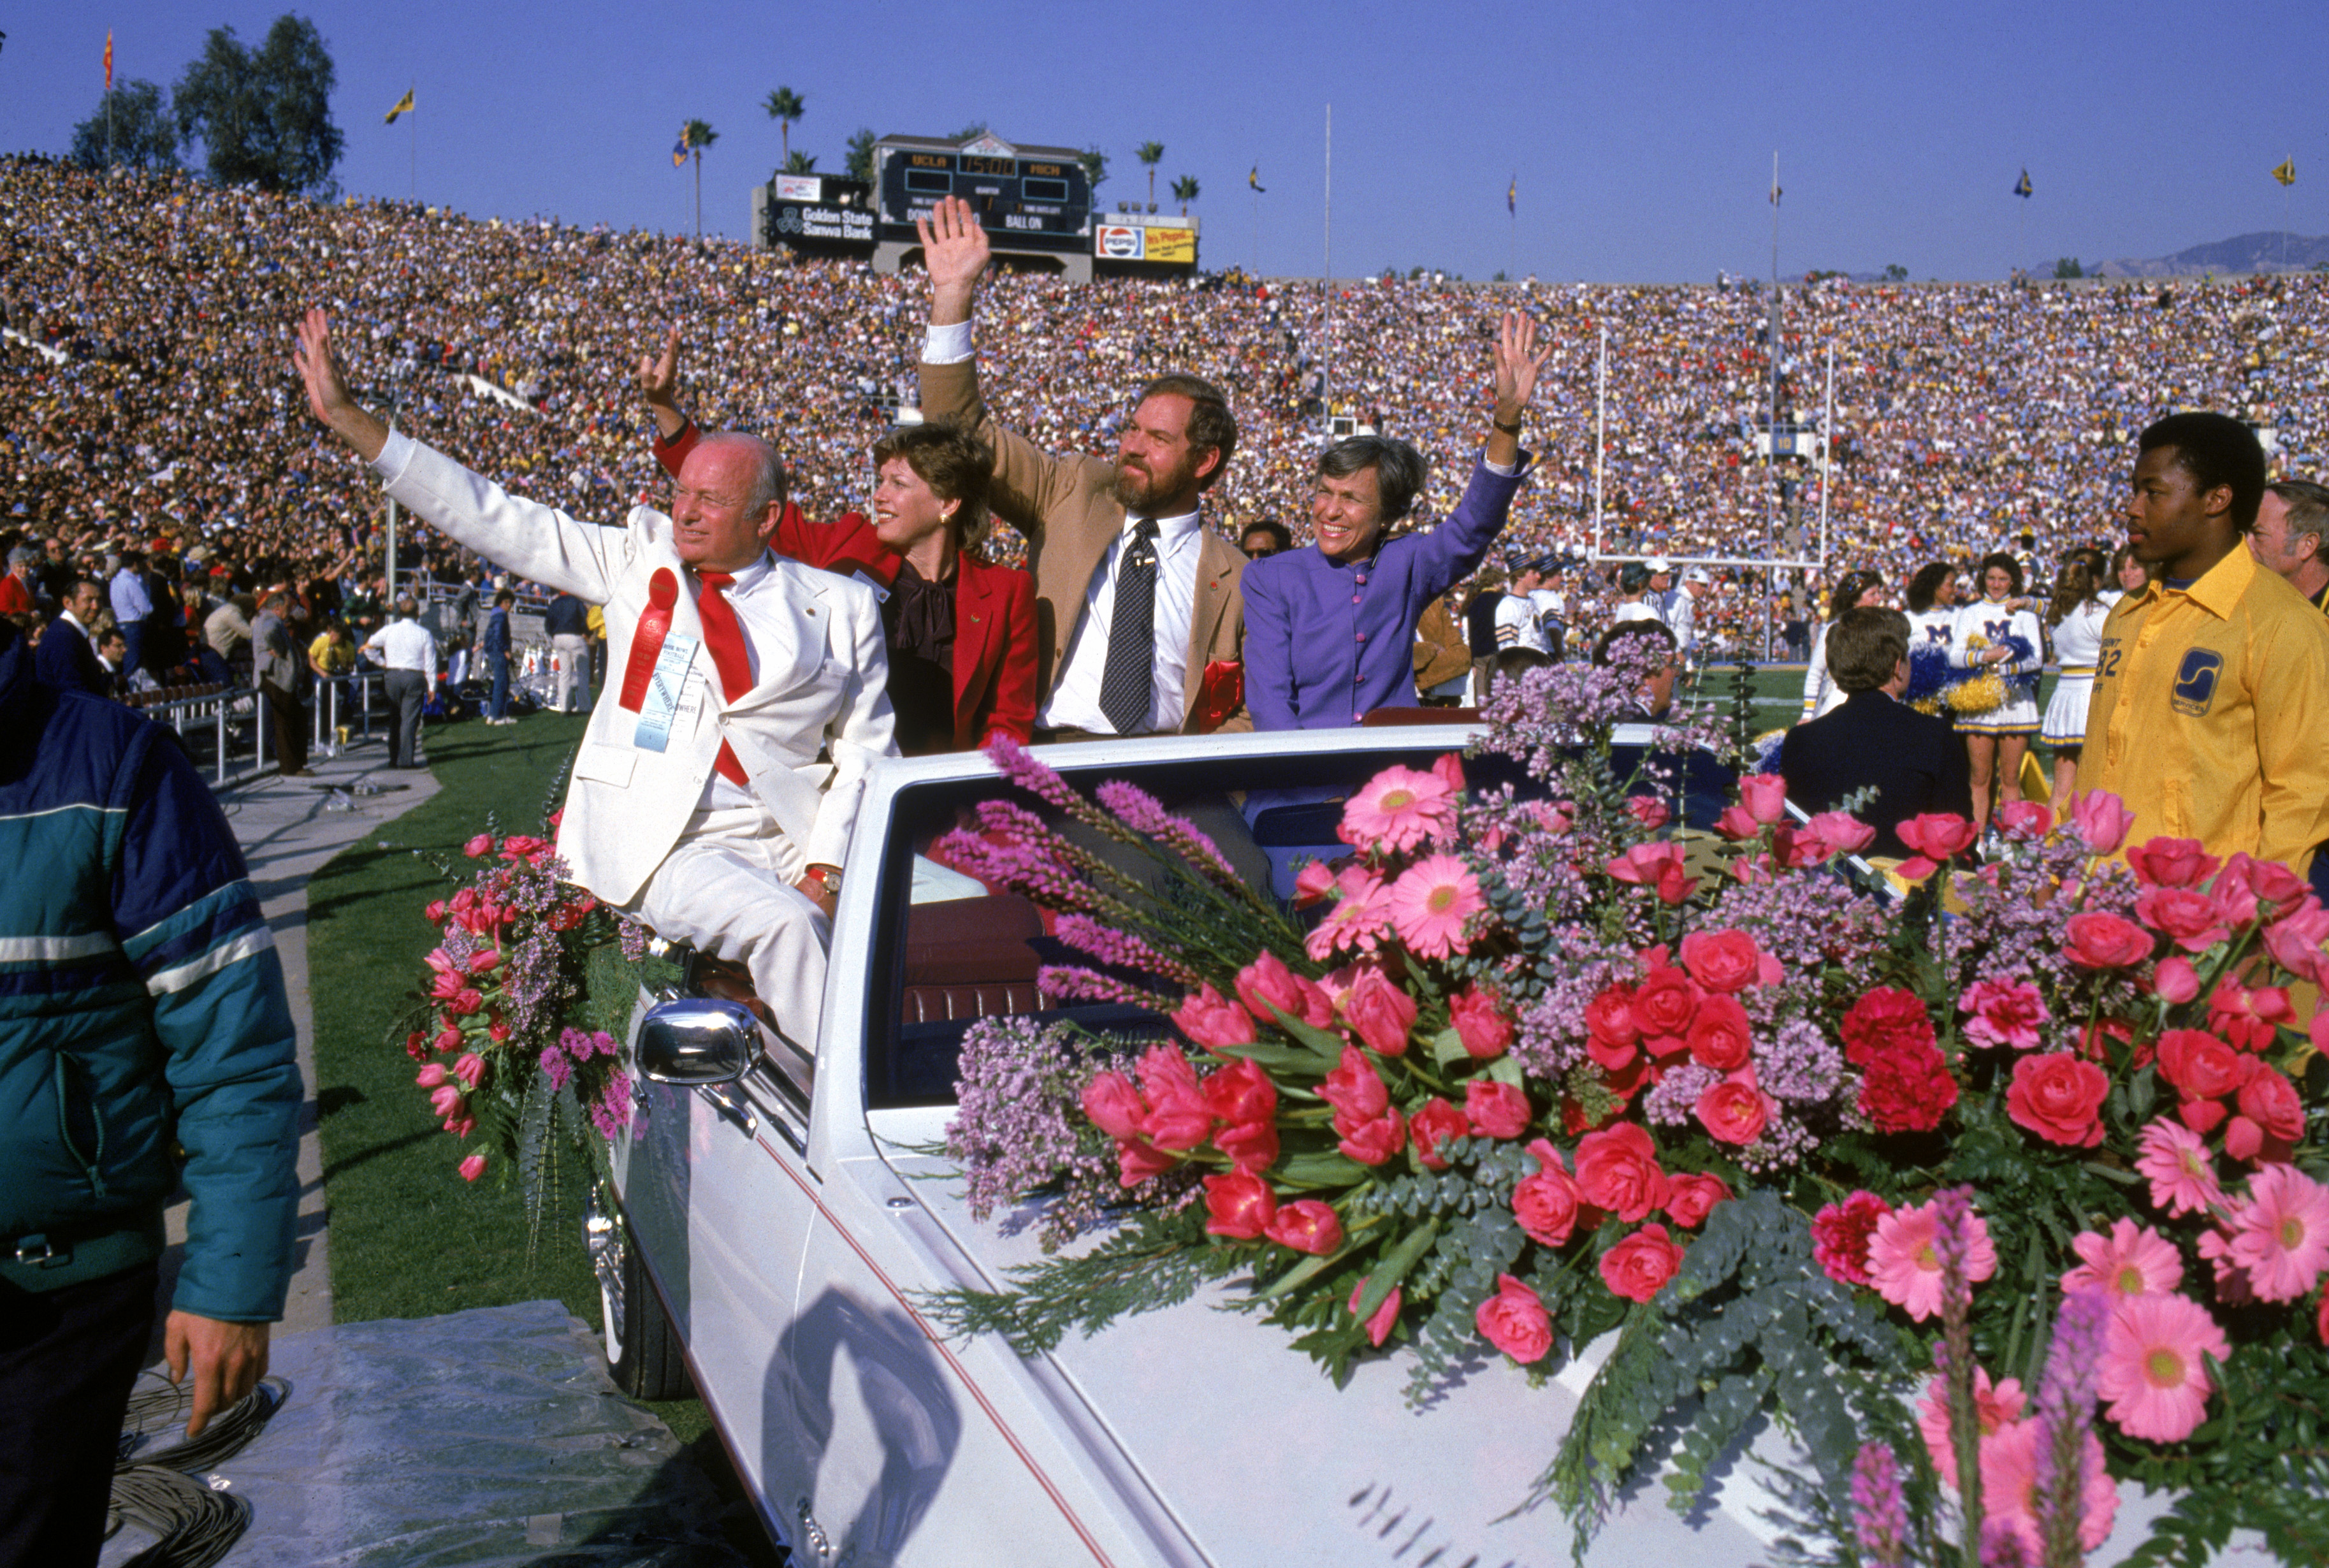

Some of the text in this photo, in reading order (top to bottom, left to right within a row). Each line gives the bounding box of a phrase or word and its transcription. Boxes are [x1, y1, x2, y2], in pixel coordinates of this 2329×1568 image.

[912, 155, 947, 168] UCLA
[966, 157, 1015, 175] 15:00
[1029, 164, 1061, 176] MICH
[802, 207, 873, 226] Golden State
[1005, 214, 1042, 229] BALL ON
[802, 221, 873, 240] Sanwa Bank
[1105, 238, 1136, 246] PEPSI
[1778, 437, 1792, 449] 10
[1925, 625, 1953, 644] M
[1984, 620, 2012, 640] M
[2102, 638, 2122, 648] ENT
[664, 650, 685, 659] FOOTBALL
[2096, 650, 2121, 676] 82
[653, 672, 674, 712] EVERYWHERE
[2093, 683, 2103, 693] FF
[677, 704, 697, 714] WHERE
